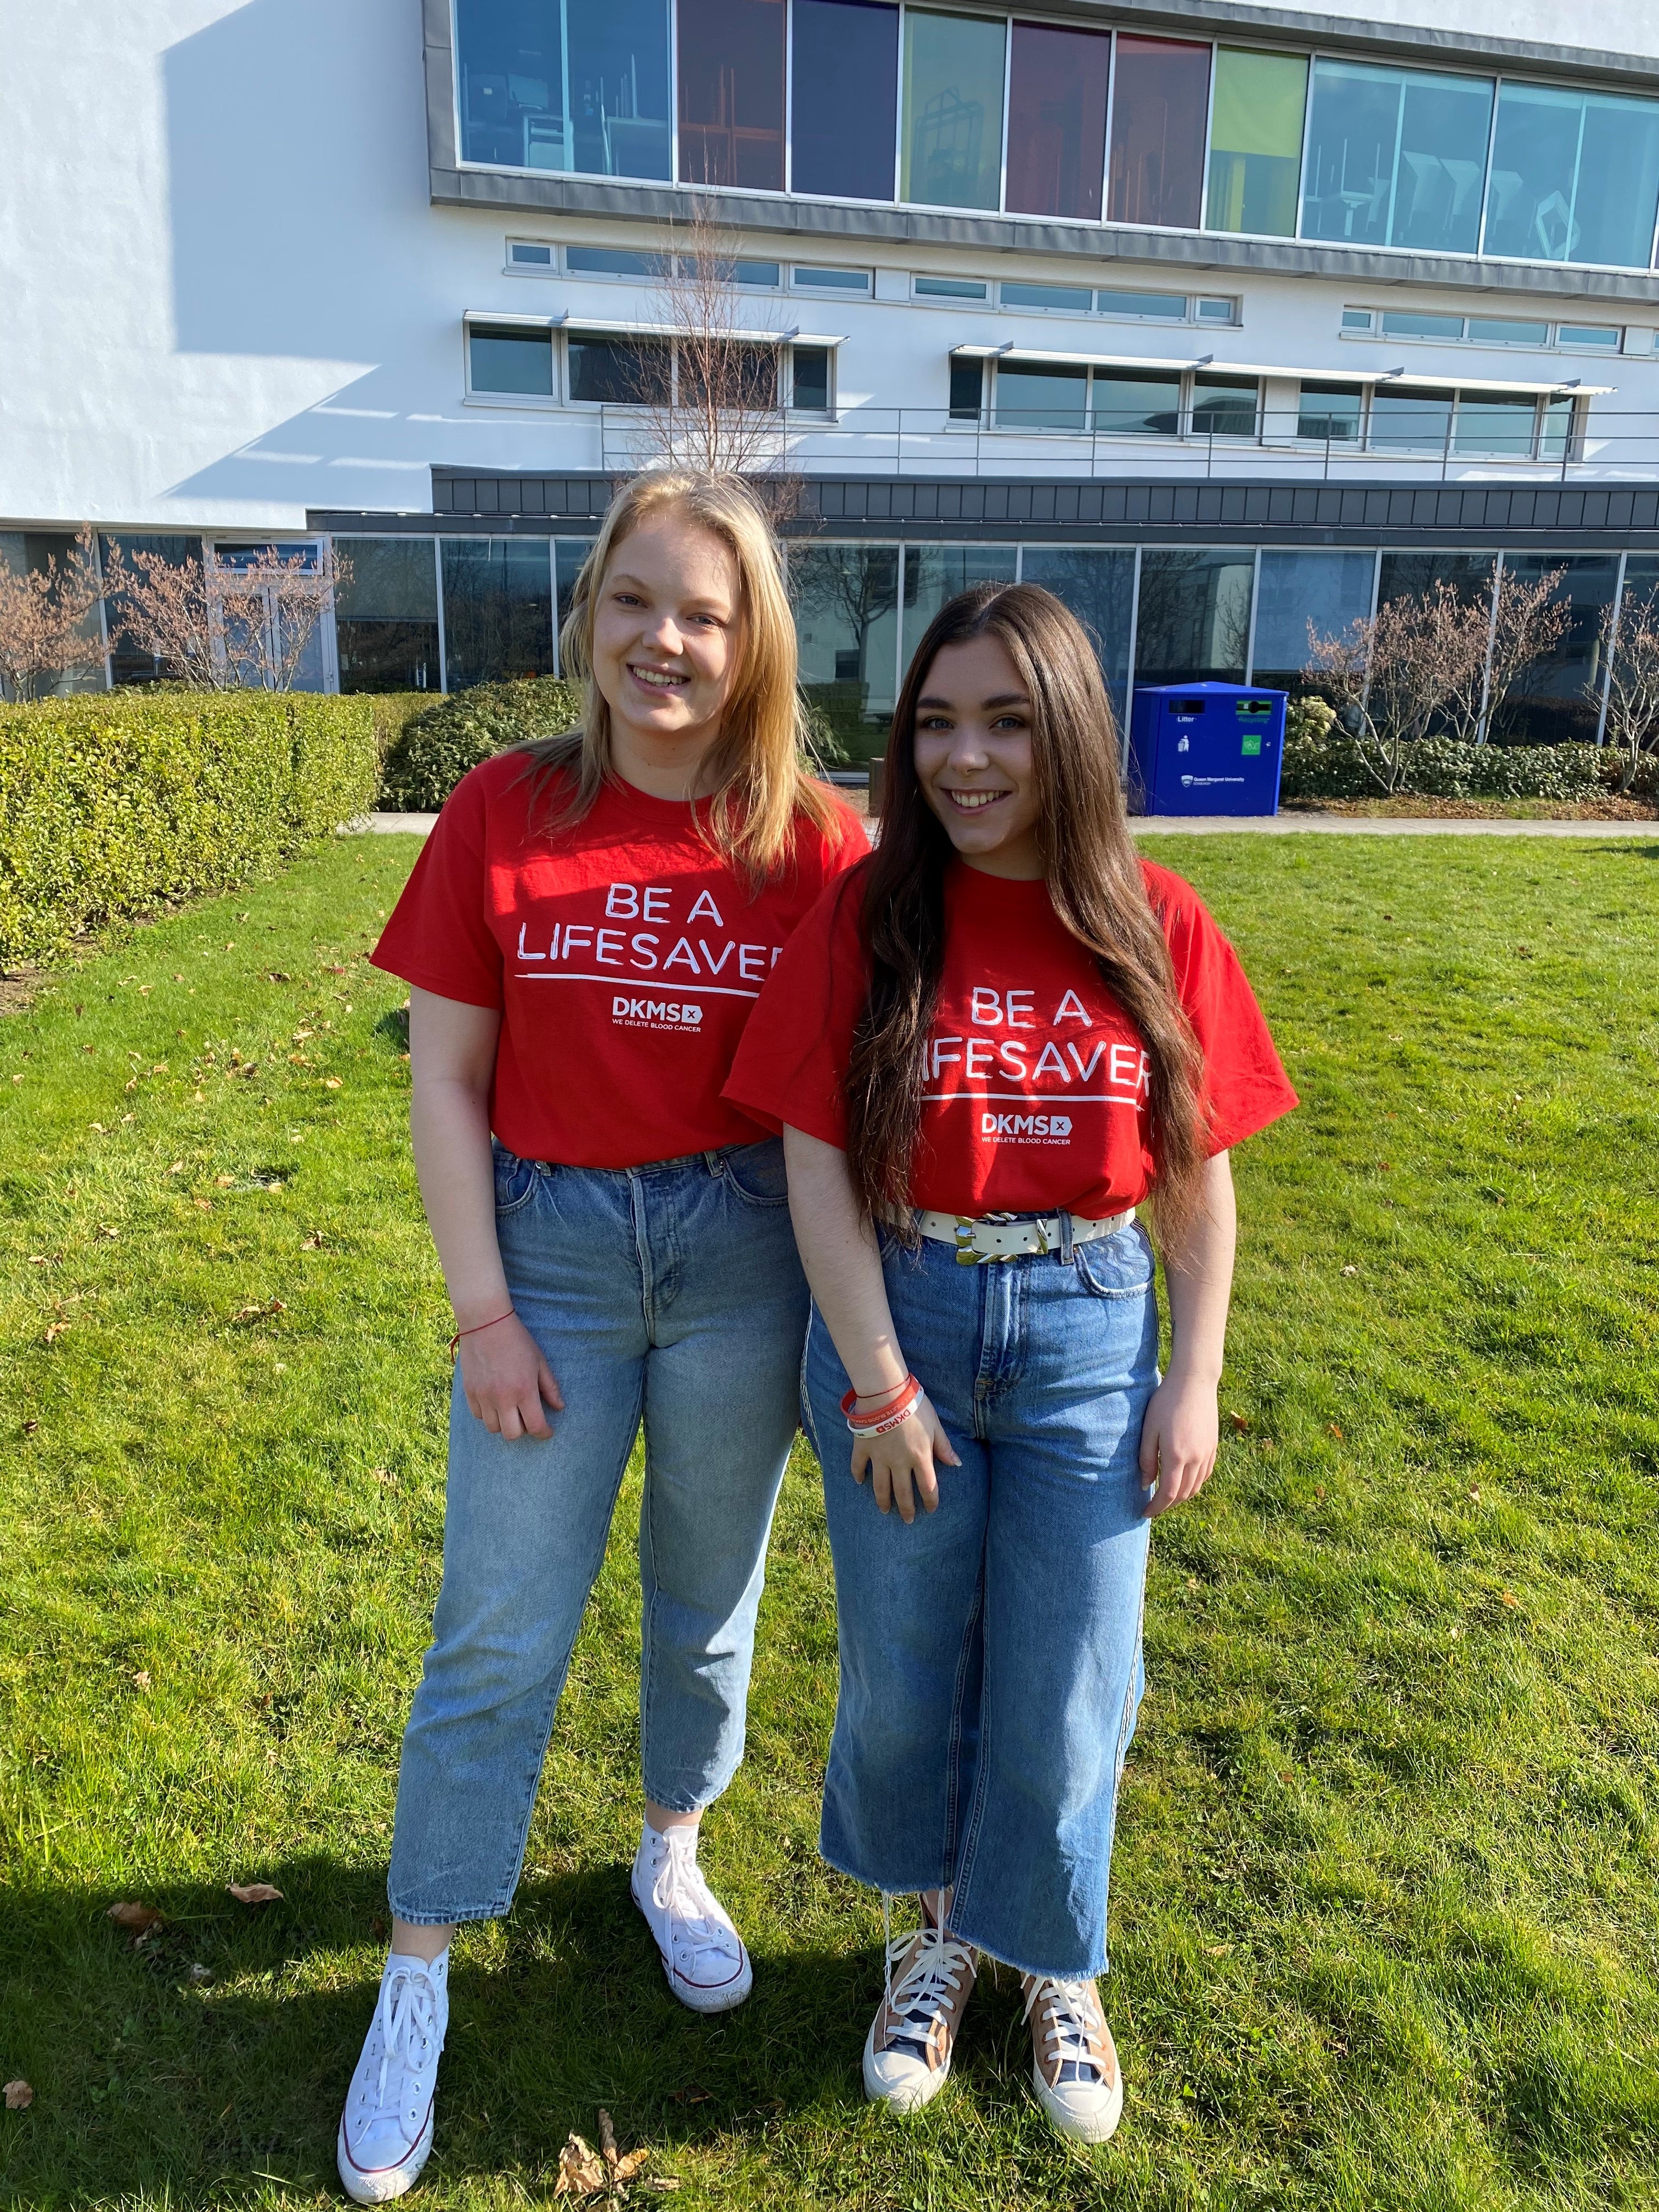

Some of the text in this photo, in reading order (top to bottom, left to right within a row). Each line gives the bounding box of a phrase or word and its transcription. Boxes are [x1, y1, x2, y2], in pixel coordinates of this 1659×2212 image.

[605, 882, 724, 926] BE A
[612, 996, 681, 1022] DKMS
[972, 986, 1092, 1028] BE A
[922, 1036, 1153, 1097] IFESAVER
[981, 1113, 1049, 1136] DKMS
[867, 1413, 886, 1423] BLOOD
[883, 1408, 911, 1430] DKMS
